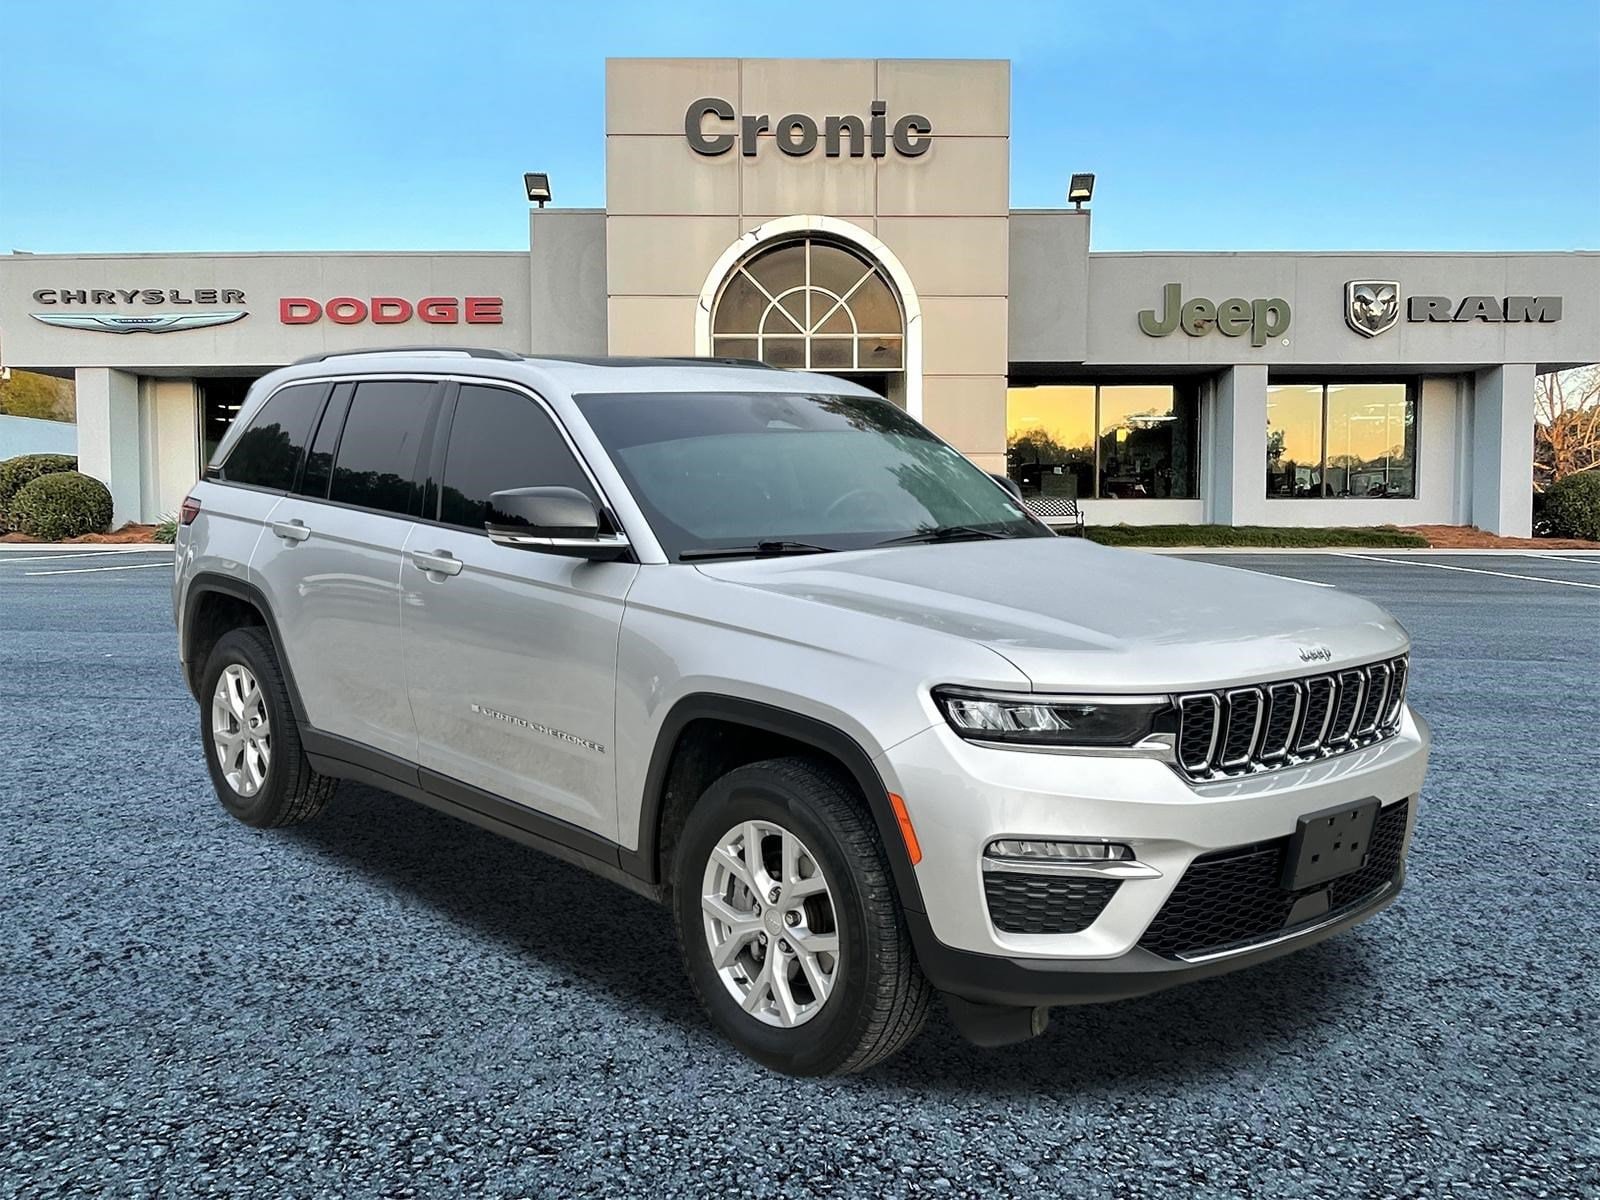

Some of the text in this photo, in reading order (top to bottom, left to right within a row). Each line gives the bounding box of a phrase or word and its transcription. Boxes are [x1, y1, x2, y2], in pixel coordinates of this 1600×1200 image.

[685, 97, 932, 157] Cronic
[32, 288, 247, 305] CHRYSLER
[279, 296, 503, 325] DODGE
[1407, 295, 1563, 323] RAM
[1138, 282, 1291, 347] Jeep
[1298, 647, 1332, 662] Jeep
[481, 708, 606, 754] GRAND CHEROKEE
